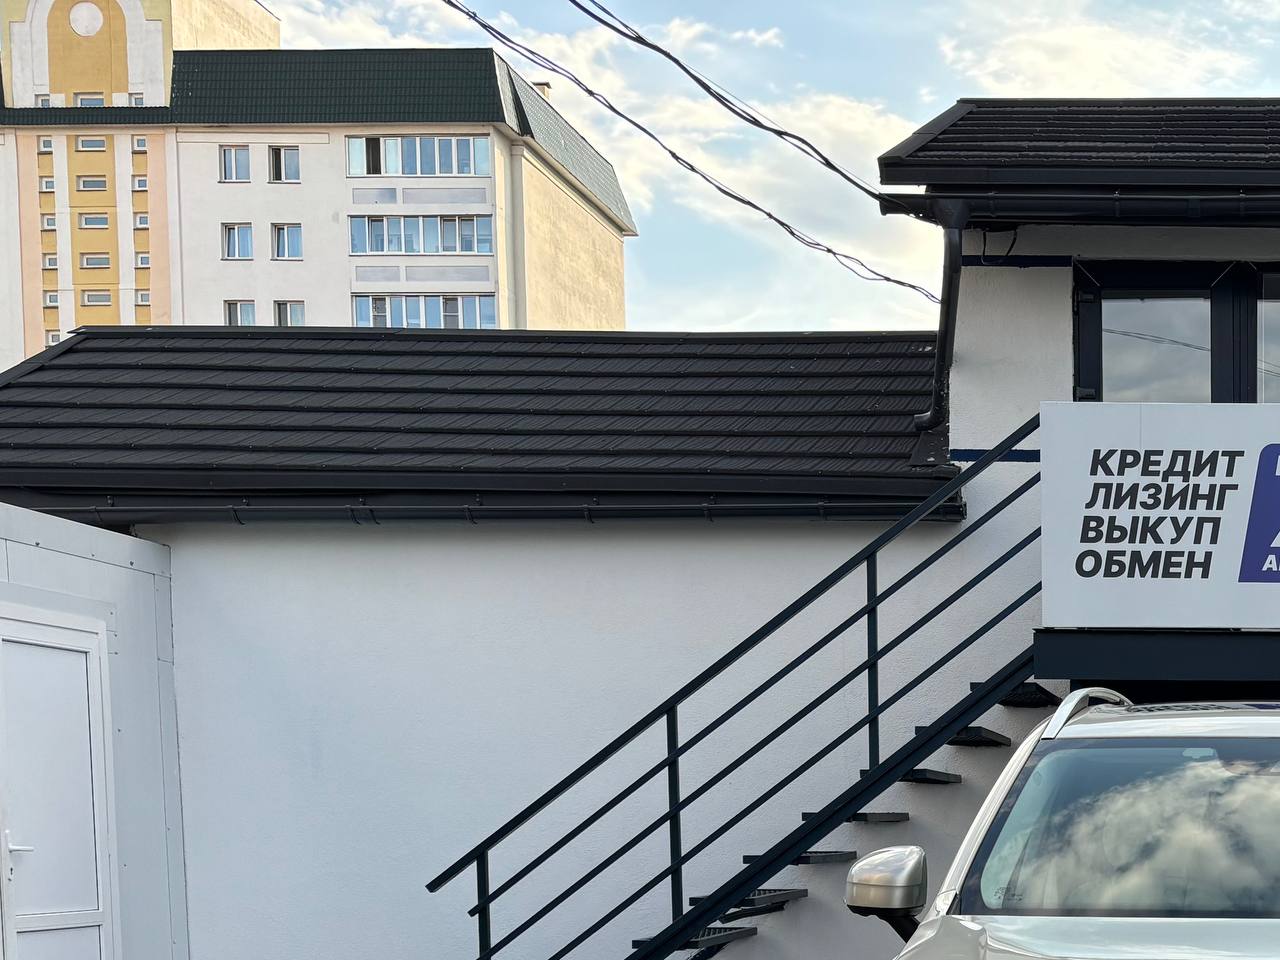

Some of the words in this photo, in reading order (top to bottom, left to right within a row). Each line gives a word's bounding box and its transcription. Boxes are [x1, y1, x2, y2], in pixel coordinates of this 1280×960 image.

[1089, 449, 1245, 482] КРЕДИТ
[1085, 483, 1238, 511] ЛИЗИНГ
[1079, 516, 1221, 545] ВЫКУП
[1074, 550, 1213, 579] ОБМЕН
